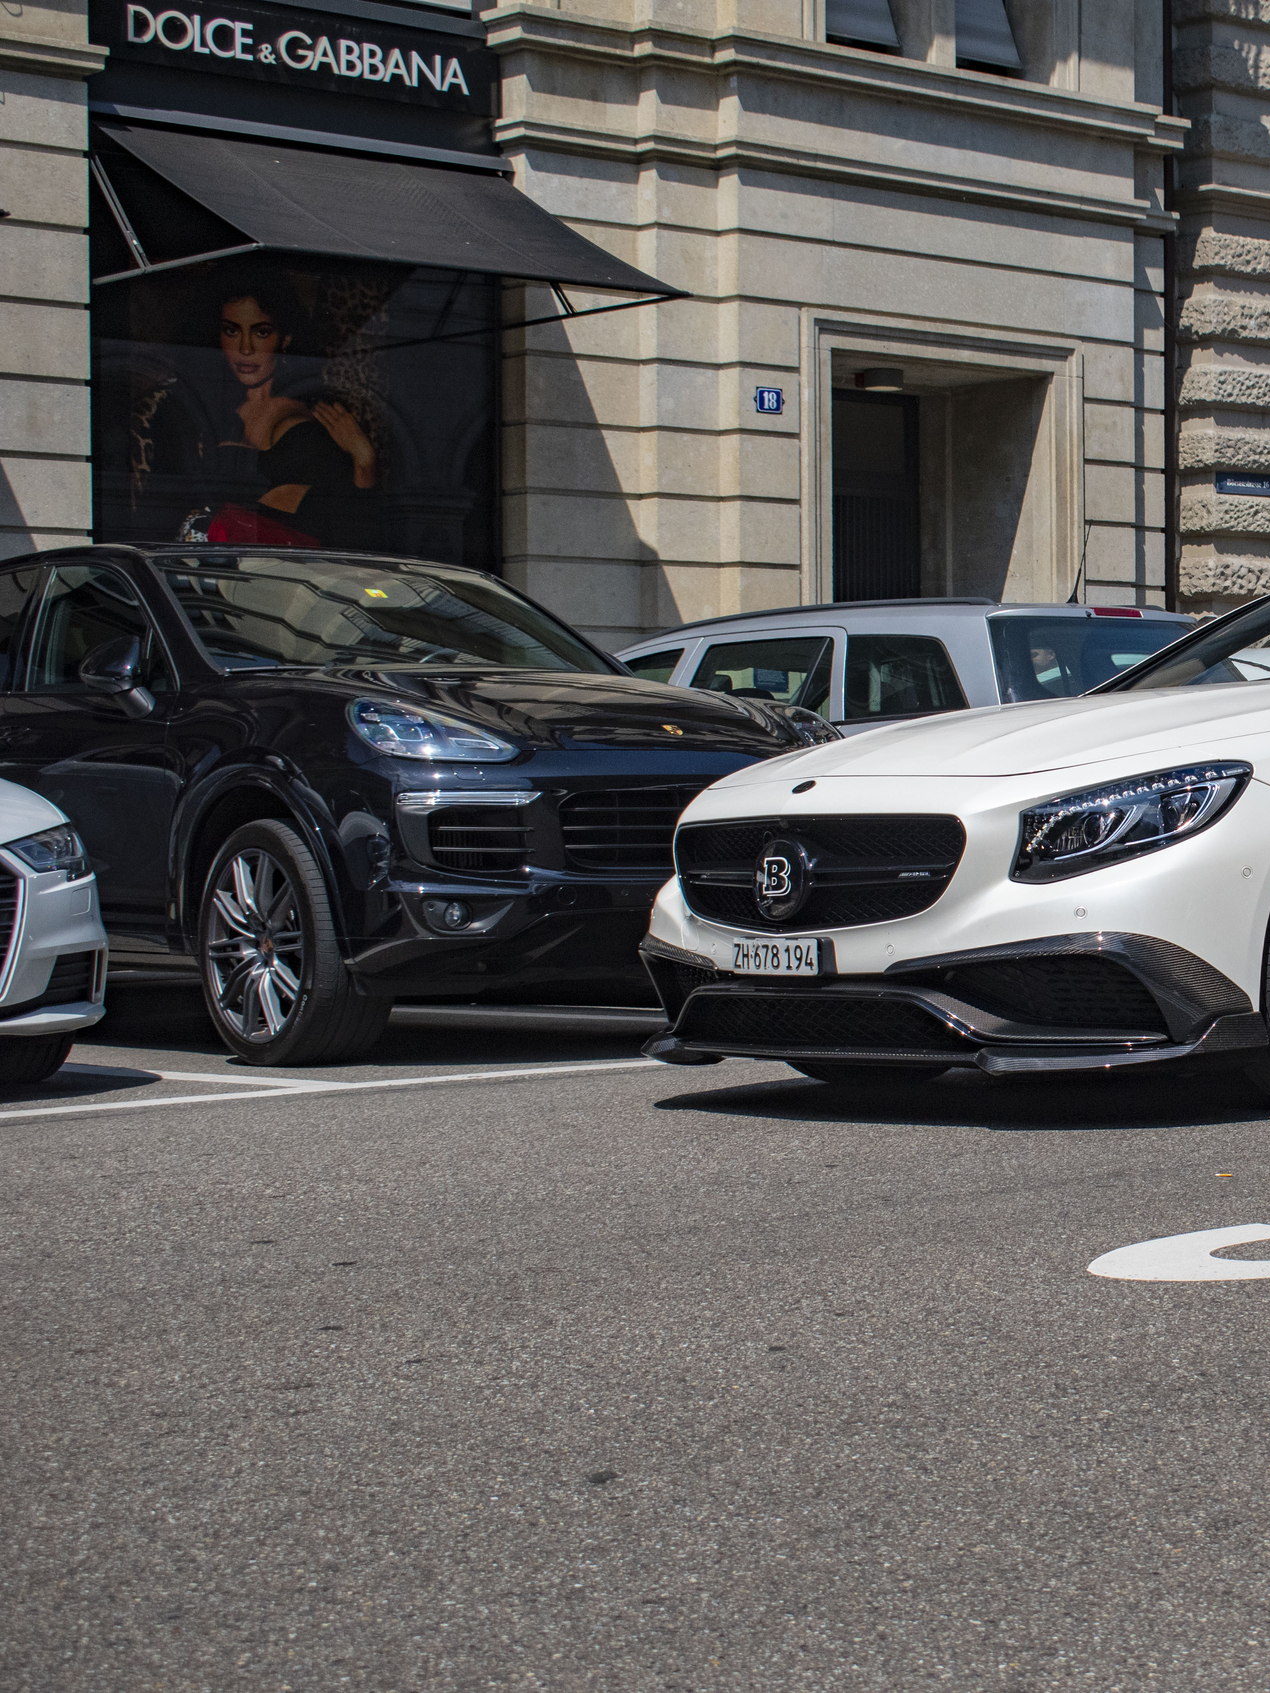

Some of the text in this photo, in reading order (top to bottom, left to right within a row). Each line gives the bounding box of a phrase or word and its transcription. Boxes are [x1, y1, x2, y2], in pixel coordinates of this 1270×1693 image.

[763, 391, 777, 410] 18
[1263, 481, 1270, 489] 16
[763, 856, 792, 897] B
[784, 945, 814, 971] 194
